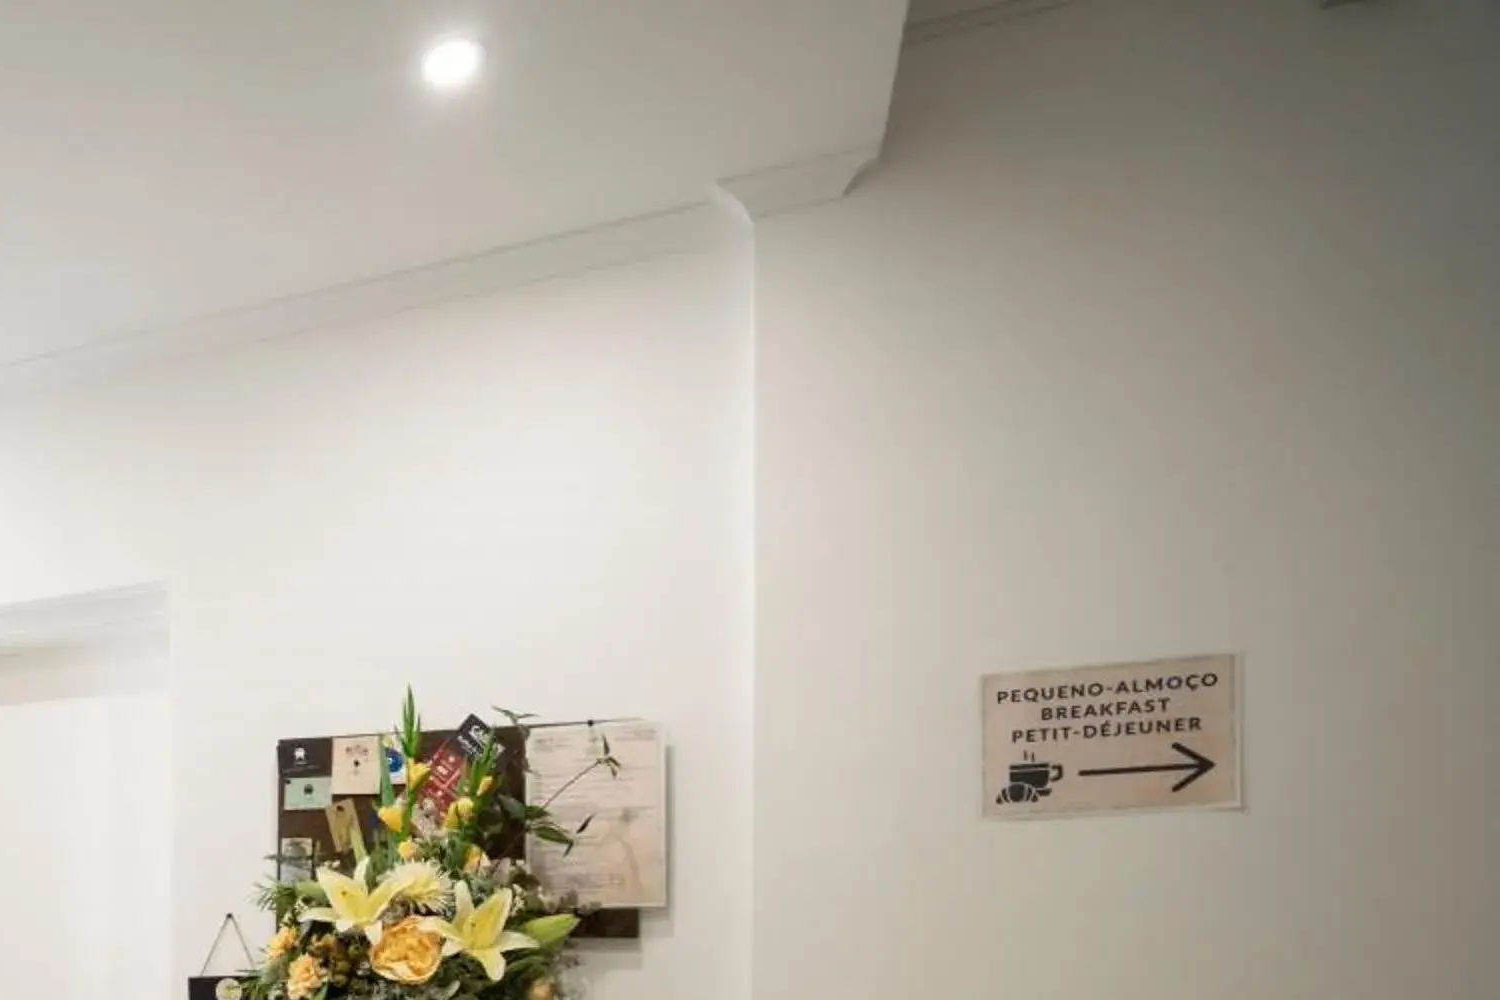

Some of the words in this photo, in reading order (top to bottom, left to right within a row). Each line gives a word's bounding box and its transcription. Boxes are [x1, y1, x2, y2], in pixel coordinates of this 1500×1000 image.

[997, 672, 1219, 705] PEQUENO-ALMOÇO
[1040, 697, 1171, 721] BREAKFAST
[1011, 716, 1203, 744] PETIT-DÉJEUNER
